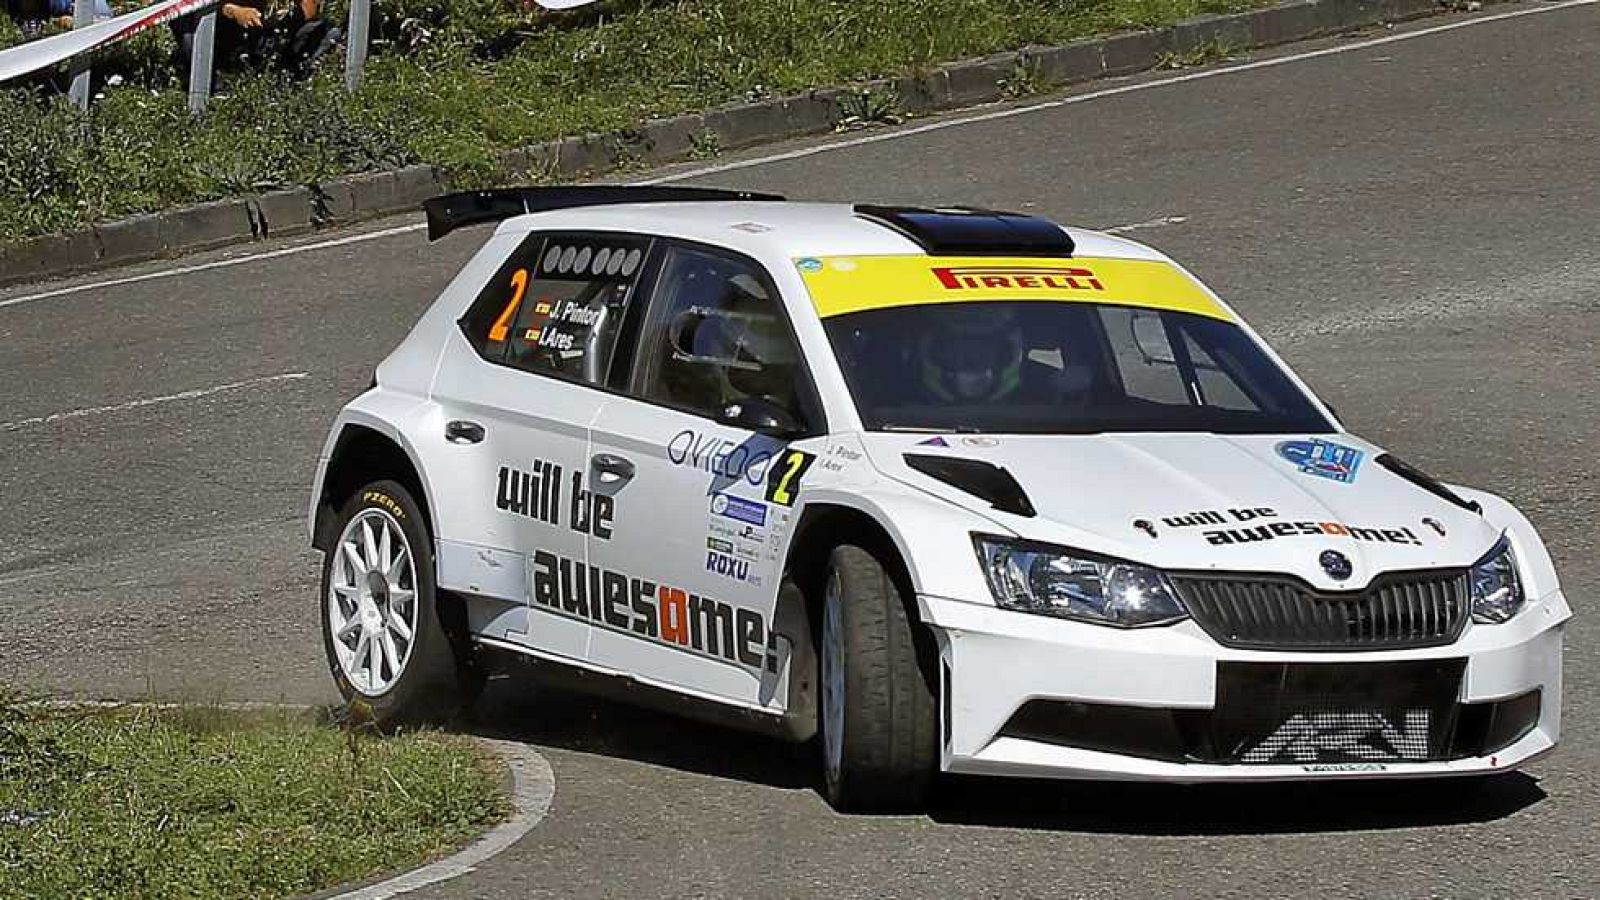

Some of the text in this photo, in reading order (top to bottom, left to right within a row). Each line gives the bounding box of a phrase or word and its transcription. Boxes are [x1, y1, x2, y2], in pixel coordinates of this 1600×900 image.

[931, 267, 1104, 290] PIRELLI
[488, 268, 528, 340] 2
[550, 300, 561, 319] J.
[668, 430, 770, 486] OVIEDO
[773, 451, 804, 505] 2
[496, 458, 615, 540] will be
[1161, 505, 1278, 529] will be
[1202, 520, 1423, 546] awesome!
[706, 551, 749, 581] ROXU
